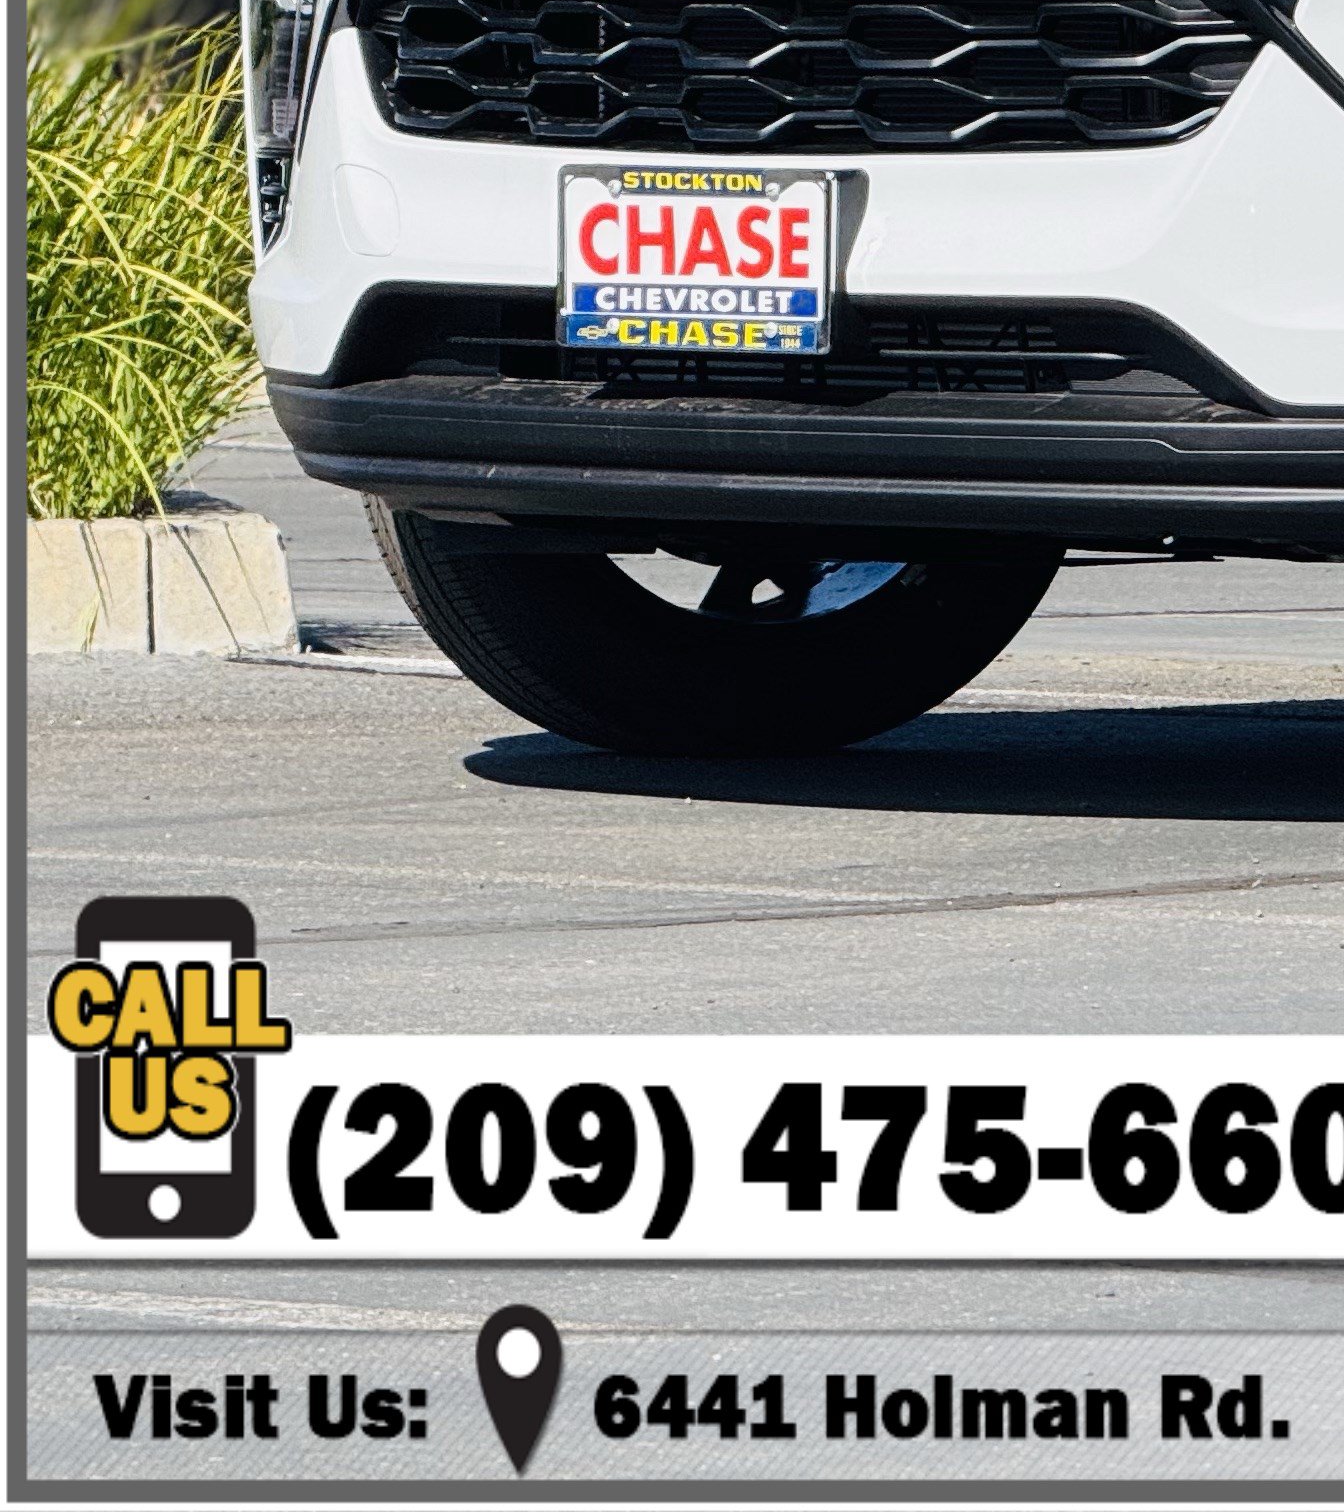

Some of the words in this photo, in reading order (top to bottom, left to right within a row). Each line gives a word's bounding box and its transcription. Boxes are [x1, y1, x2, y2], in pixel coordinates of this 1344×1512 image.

[622, 171, 762, 192] STOCKTON
[578, 202, 810, 279] CHASE
[595, 287, 792, 314] CHEVROLET
[617, 319, 768, 348] CHASE
